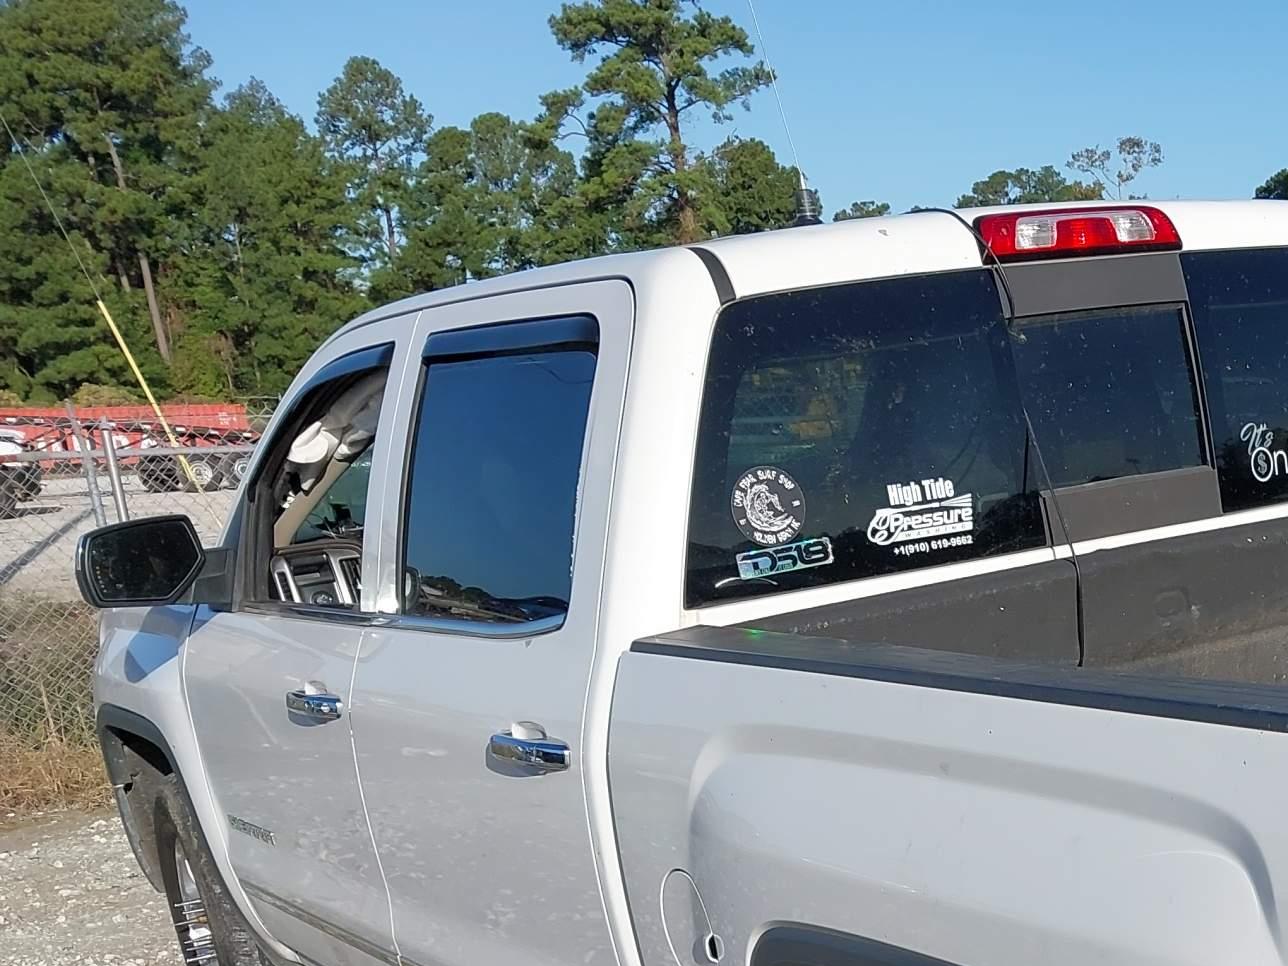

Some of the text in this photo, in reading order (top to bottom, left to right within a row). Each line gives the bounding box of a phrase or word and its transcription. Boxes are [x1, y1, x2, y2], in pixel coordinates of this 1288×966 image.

[1240, 422, 1274, 454] It's
[756, 469, 777, 480] SURF
[887, 477, 955, 506] High Tide
[889, 507, 973, 533] Pressure
